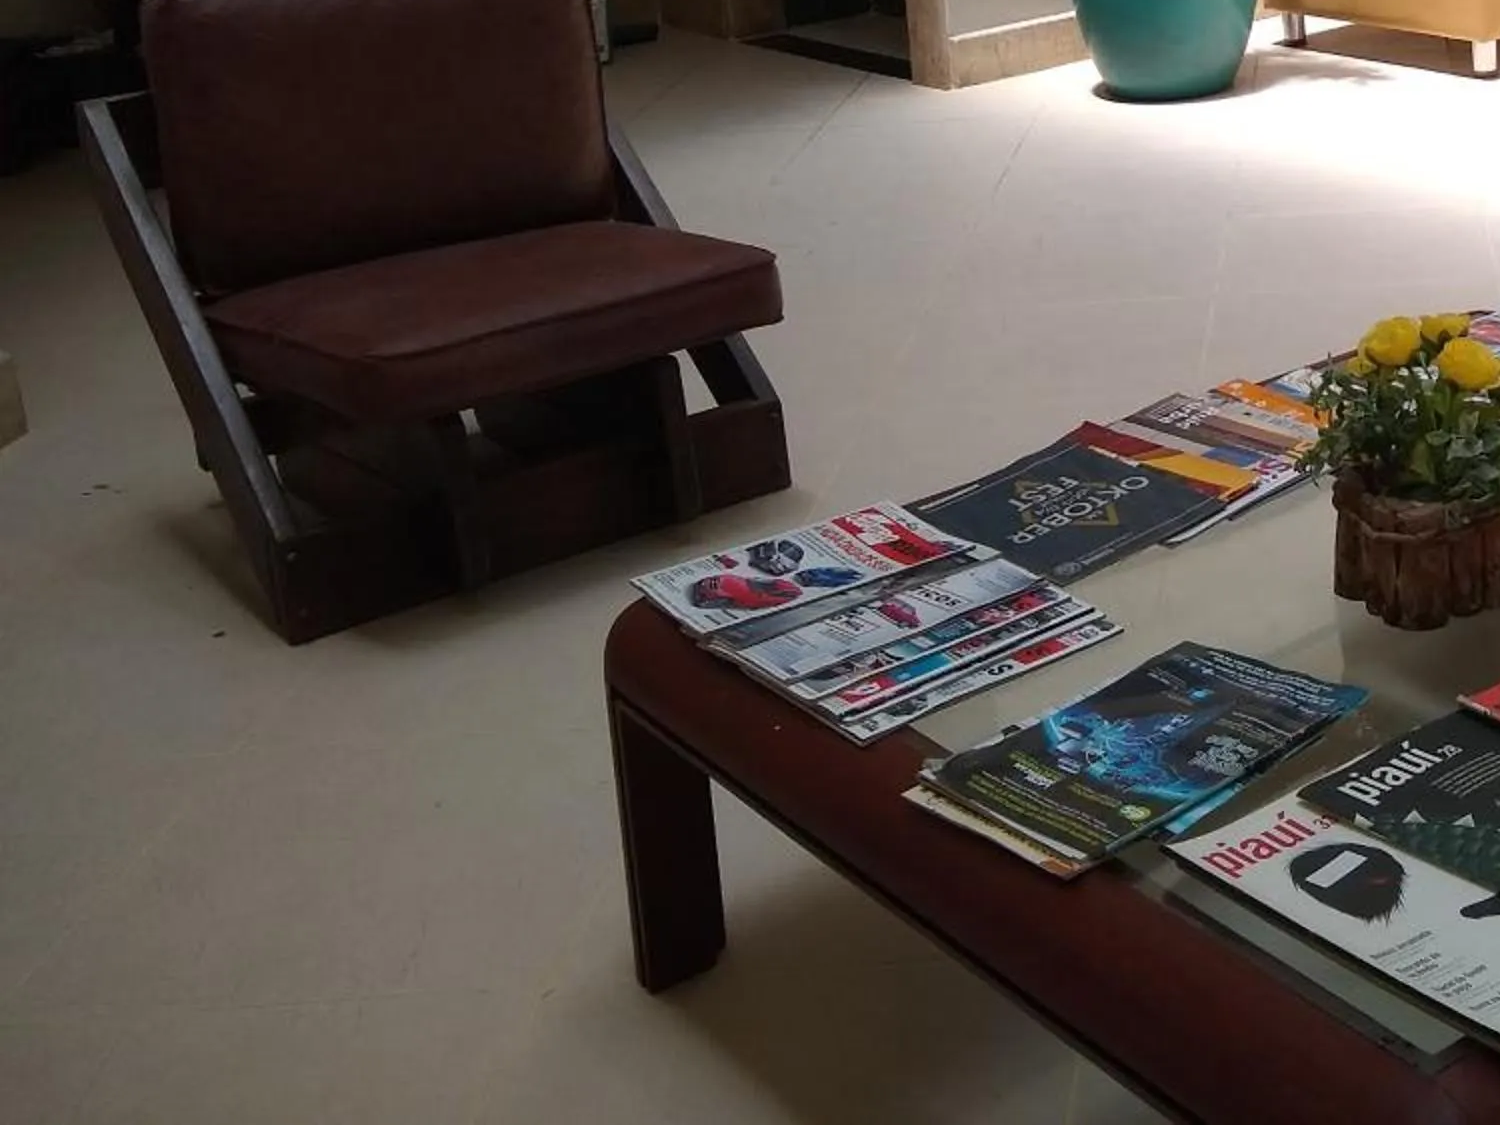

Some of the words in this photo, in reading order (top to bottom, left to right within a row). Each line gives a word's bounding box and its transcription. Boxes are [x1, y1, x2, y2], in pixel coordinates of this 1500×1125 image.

[1006, 476, 1150, 544] OKTOBER
[1008, 476, 1080, 512] FEST
[1336, 740, 1443, 806] piauí
[1200, 810, 1316, 879] piauí
